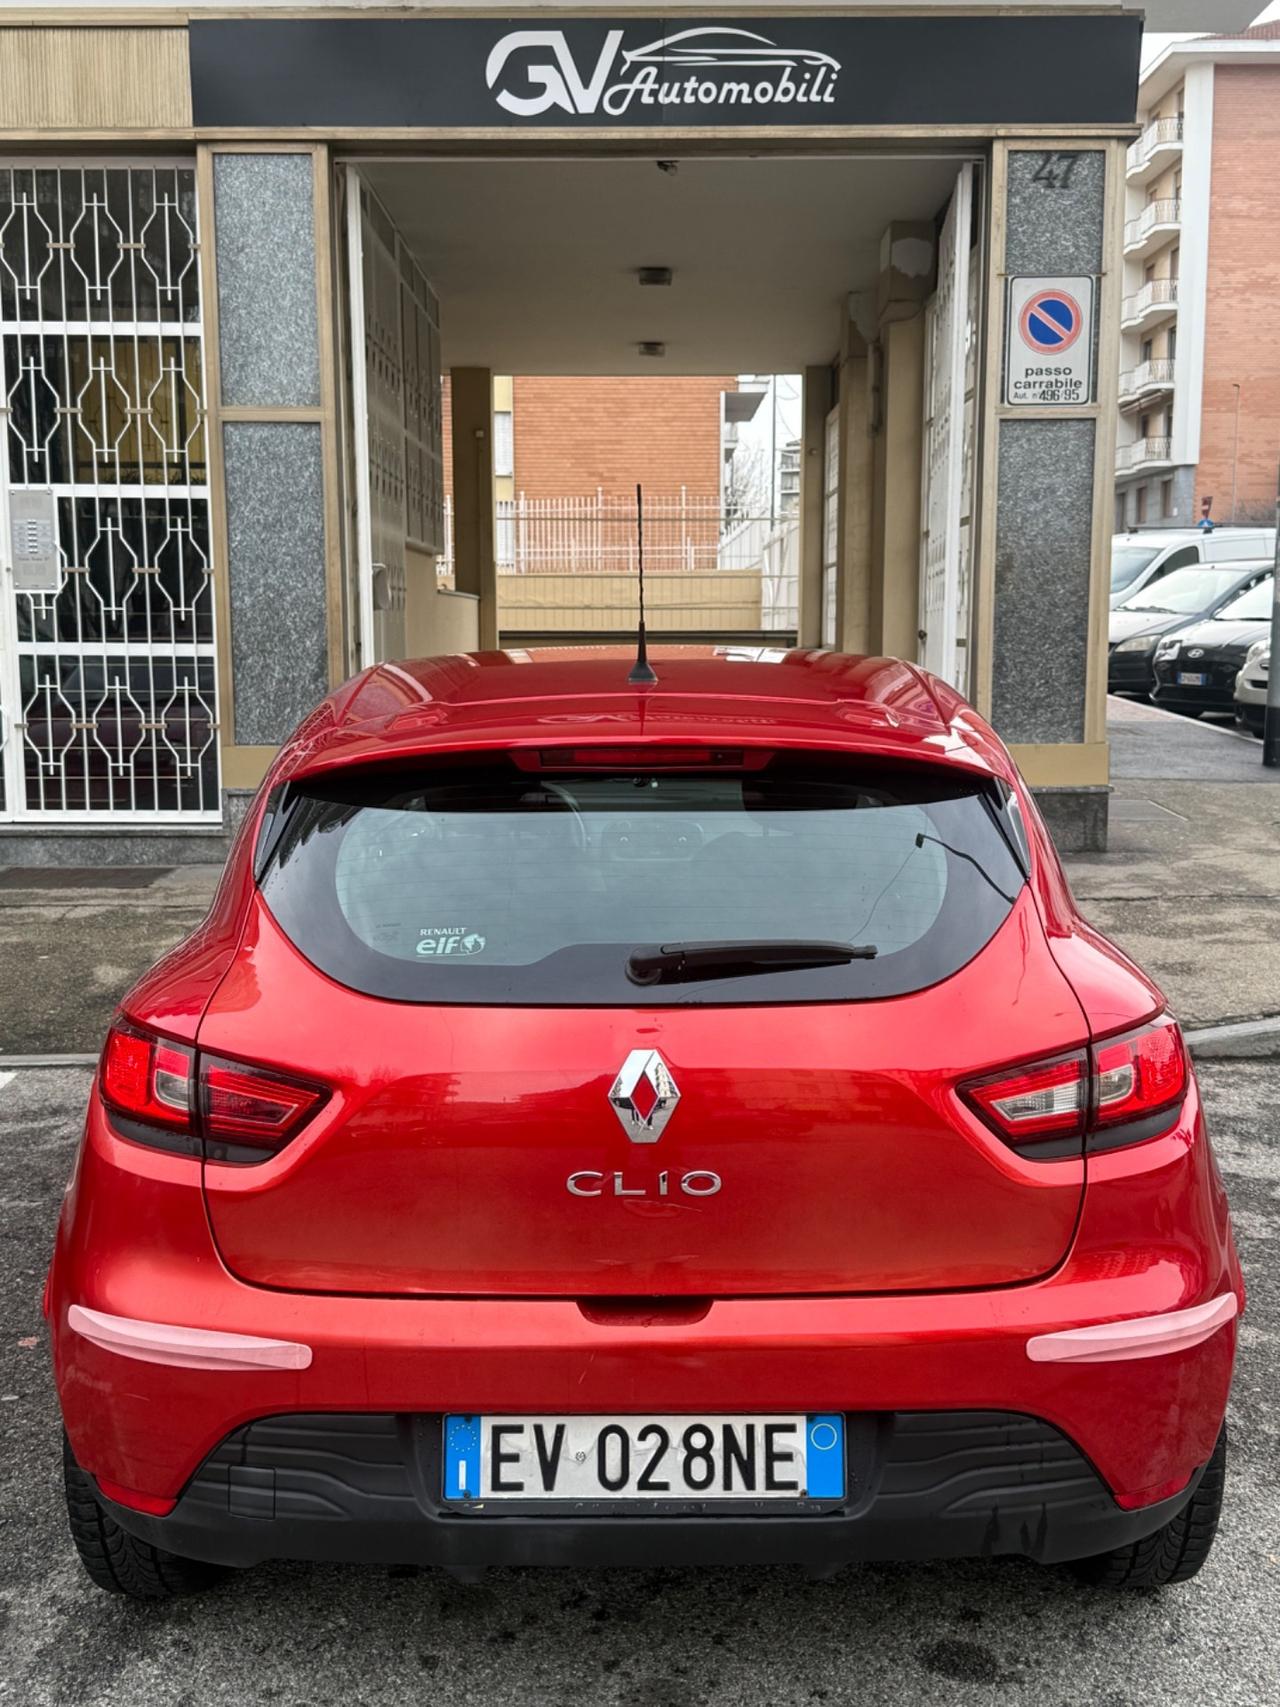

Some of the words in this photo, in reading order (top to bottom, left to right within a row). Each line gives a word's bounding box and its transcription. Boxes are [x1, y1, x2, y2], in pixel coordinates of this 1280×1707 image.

[486, 30, 625, 116] GV
[602, 66, 838, 116] Automobili
[1032, 151, 1079, 189] 47
[1013, 378, 1083, 389] carrabile
[1025, 367, 1072, 378] passo
[420, 927, 467, 936] RENAULT
[416, 936, 460, 954] elf
[566, 1170, 722, 1197] CLIO
[491, 1423, 566, 1492] EV
[597, 1423, 800, 1492] 028NE
